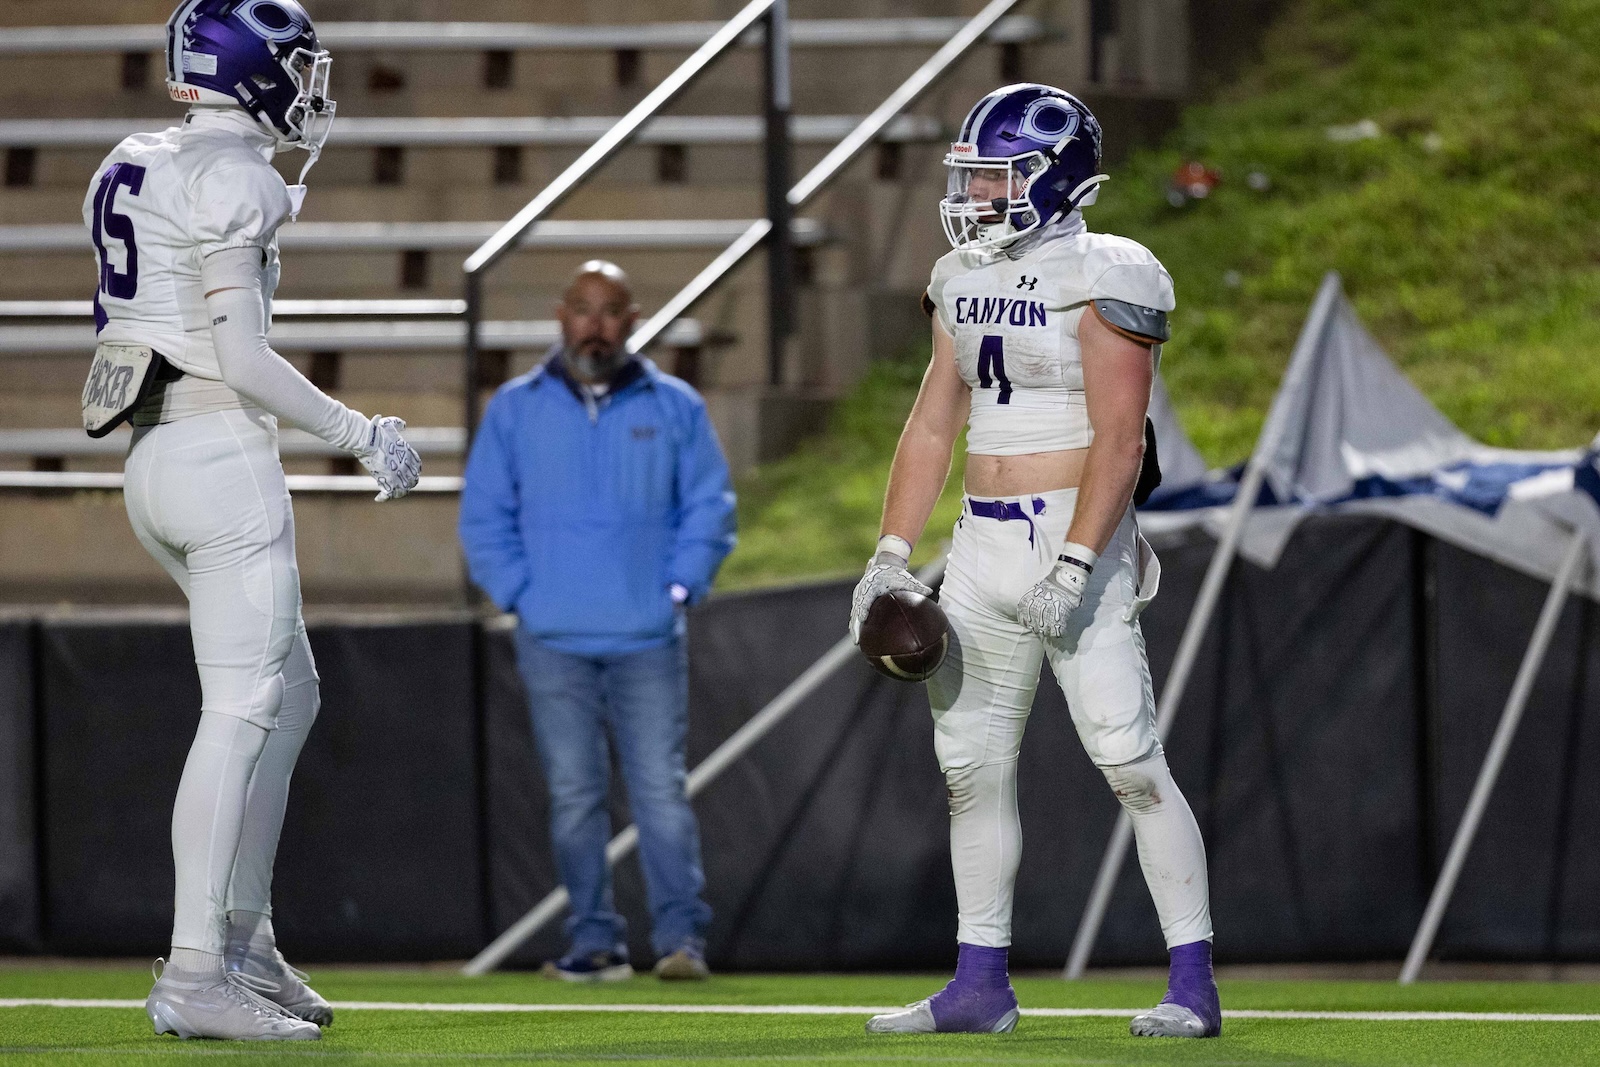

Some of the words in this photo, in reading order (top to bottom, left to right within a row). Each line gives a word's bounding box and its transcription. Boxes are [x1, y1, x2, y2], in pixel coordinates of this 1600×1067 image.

[1016, 96, 1080, 145] C
[956, 297, 1047, 327] CANYON
[977, 335, 1013, 405] 4
